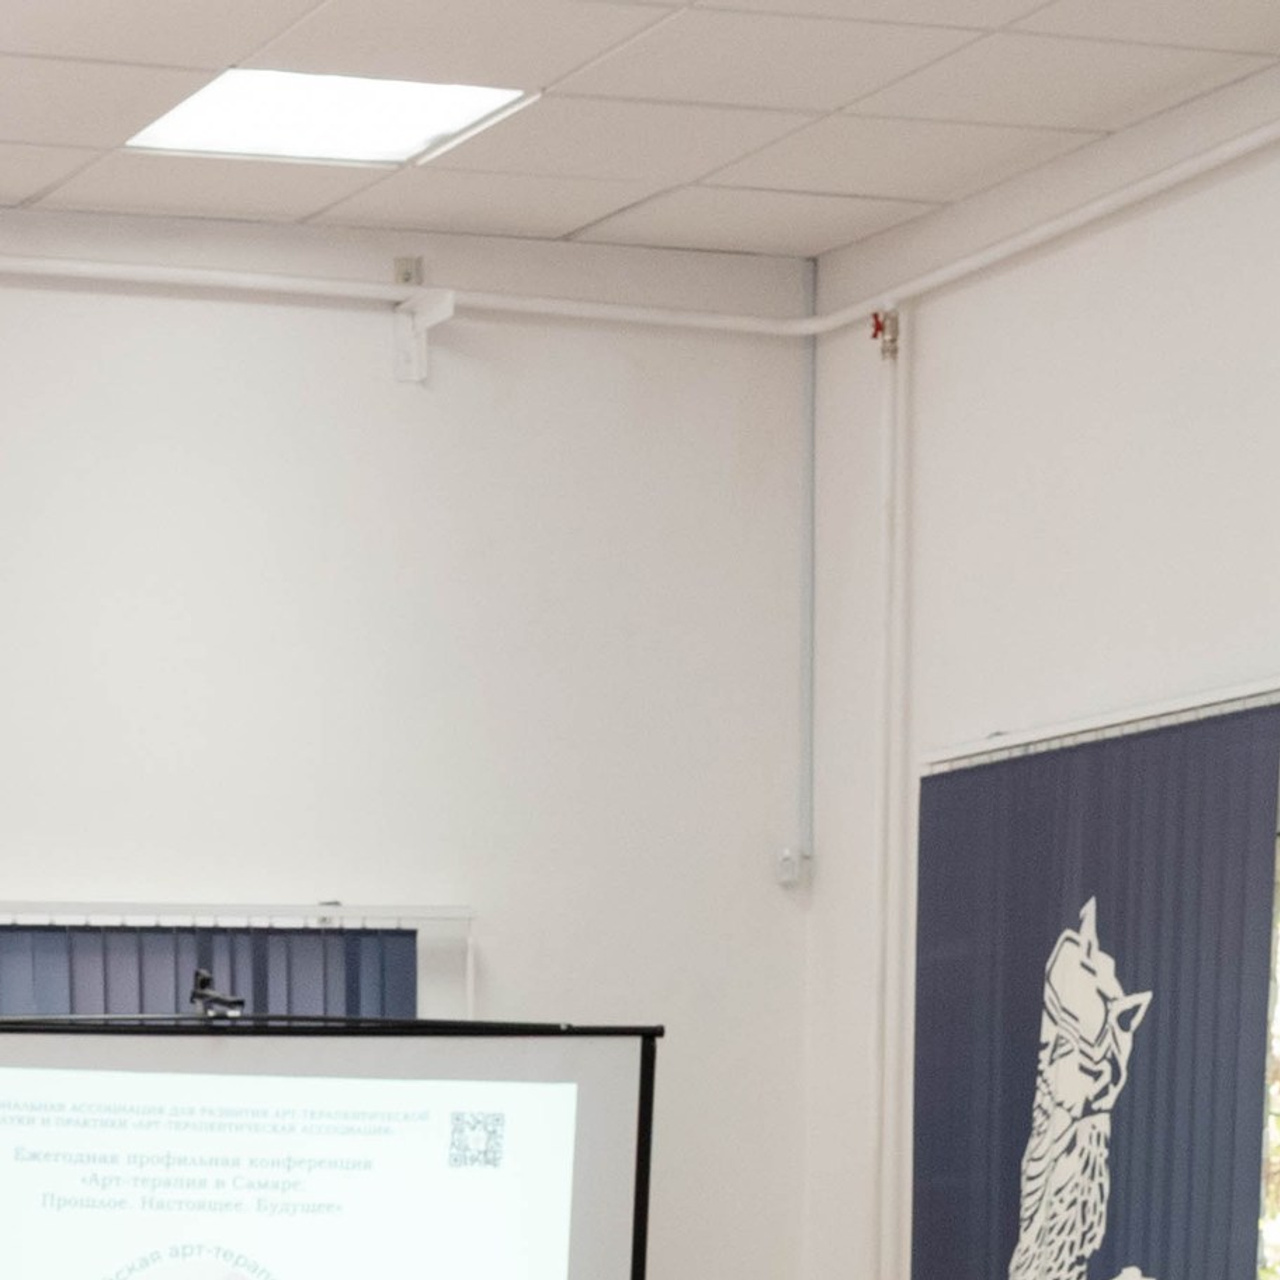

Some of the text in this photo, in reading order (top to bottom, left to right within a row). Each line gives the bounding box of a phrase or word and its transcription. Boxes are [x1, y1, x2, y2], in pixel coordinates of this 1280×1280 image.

[13, 1146, 373, 1173] Ежегодная профильная конференция
